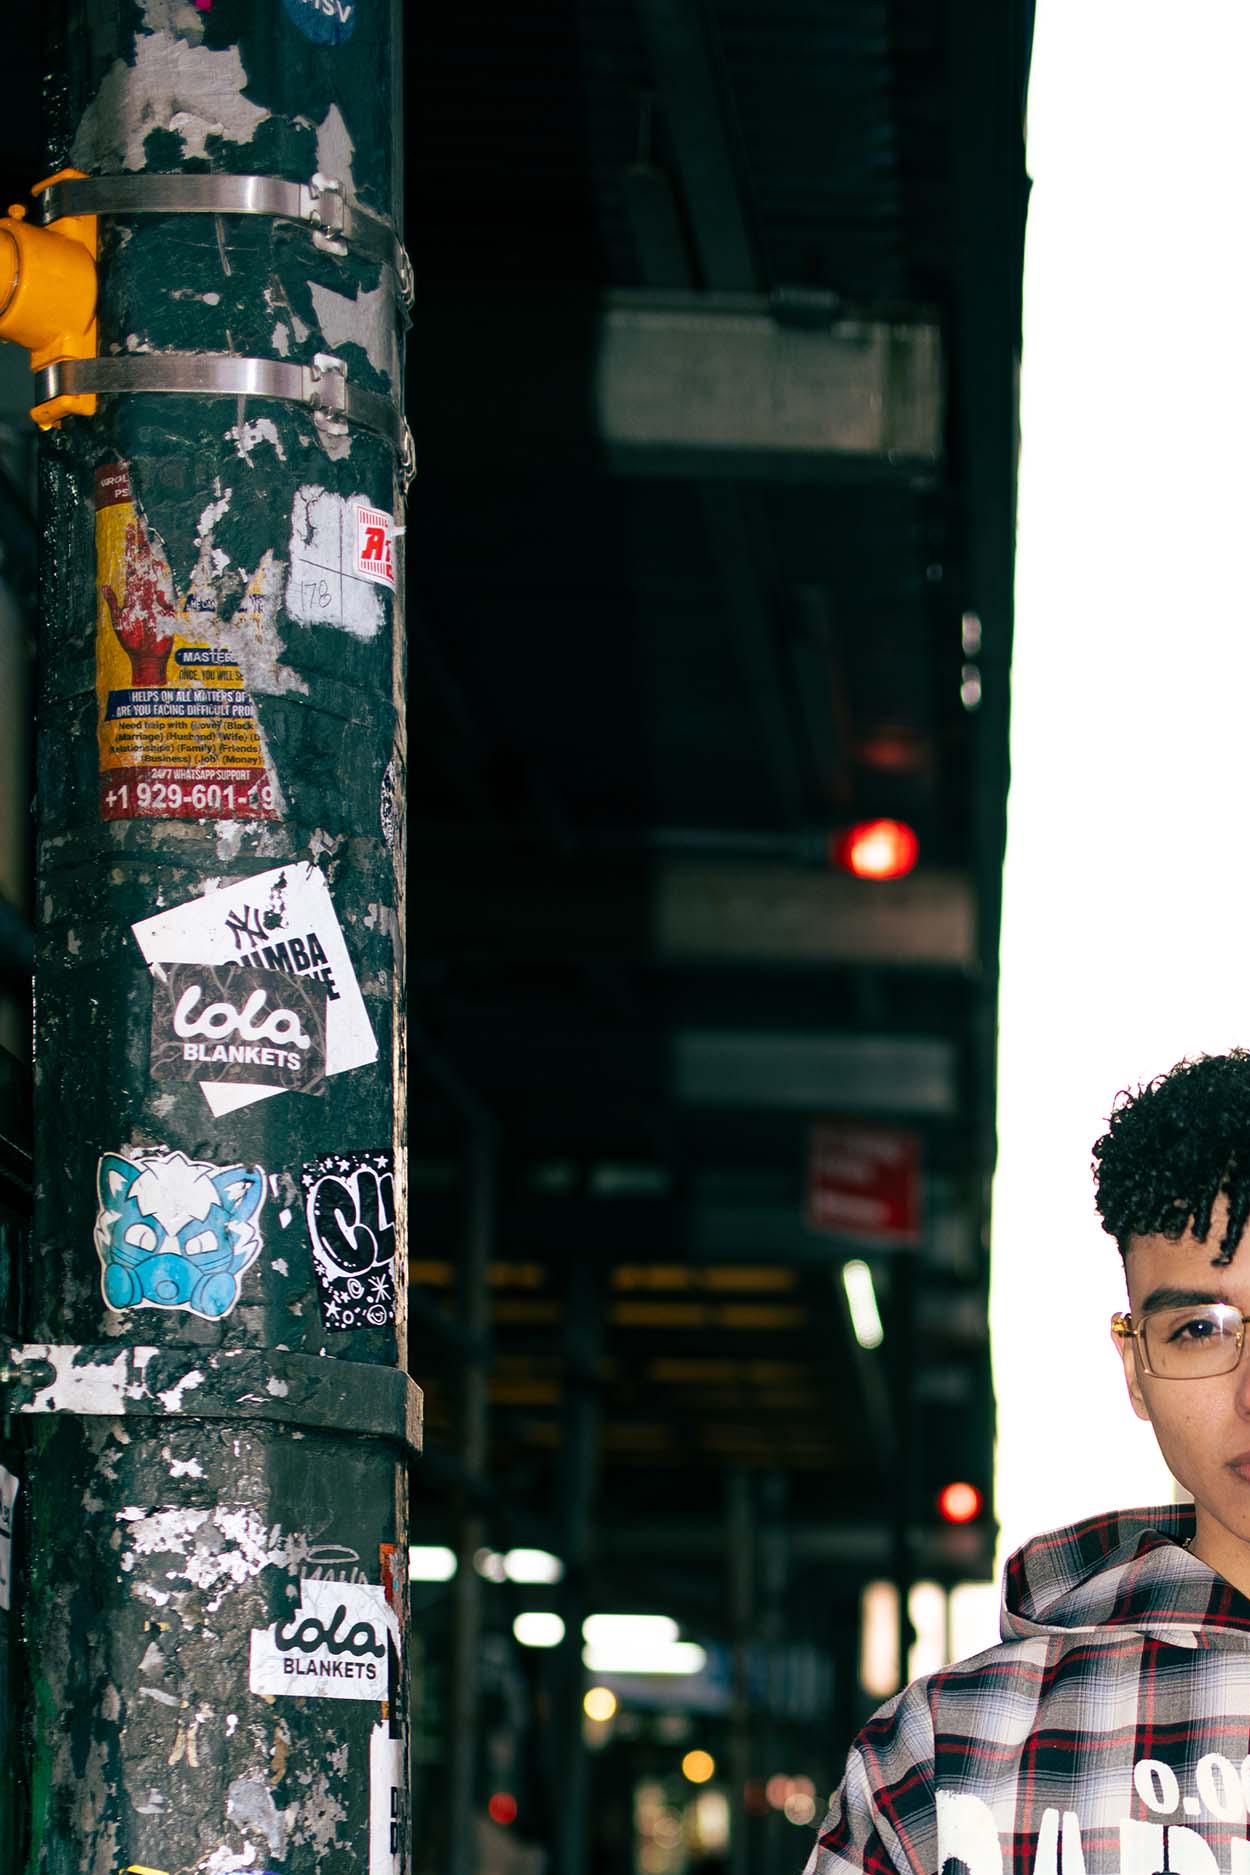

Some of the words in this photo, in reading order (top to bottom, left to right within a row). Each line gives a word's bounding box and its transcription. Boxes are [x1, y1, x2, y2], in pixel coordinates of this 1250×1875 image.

[132, 692, 159, 702] HELPS
[161, 692, 175, 703] ON
[176, 691, 192, 702] ALL
[193, 691, 233, 702] MATTERS
[116, 705, 132, 717] ARE
[133, 705, 151, 716] YOU
[153, 705, 184, 716] FACING
[187, 705, 229, 716] DIFFICULT
[119, 722, 142, 730] Need
[167, 721, 188, 729] with
[174, 769, 216, 780] WHATSAPP
[217, 769, 250, 780] SUPPORT
[105, 785, 129, 809] +1
[183, 1042, 301, 1071] BLANKETS
[283, 1657, 377, 1680] BLANKETS
